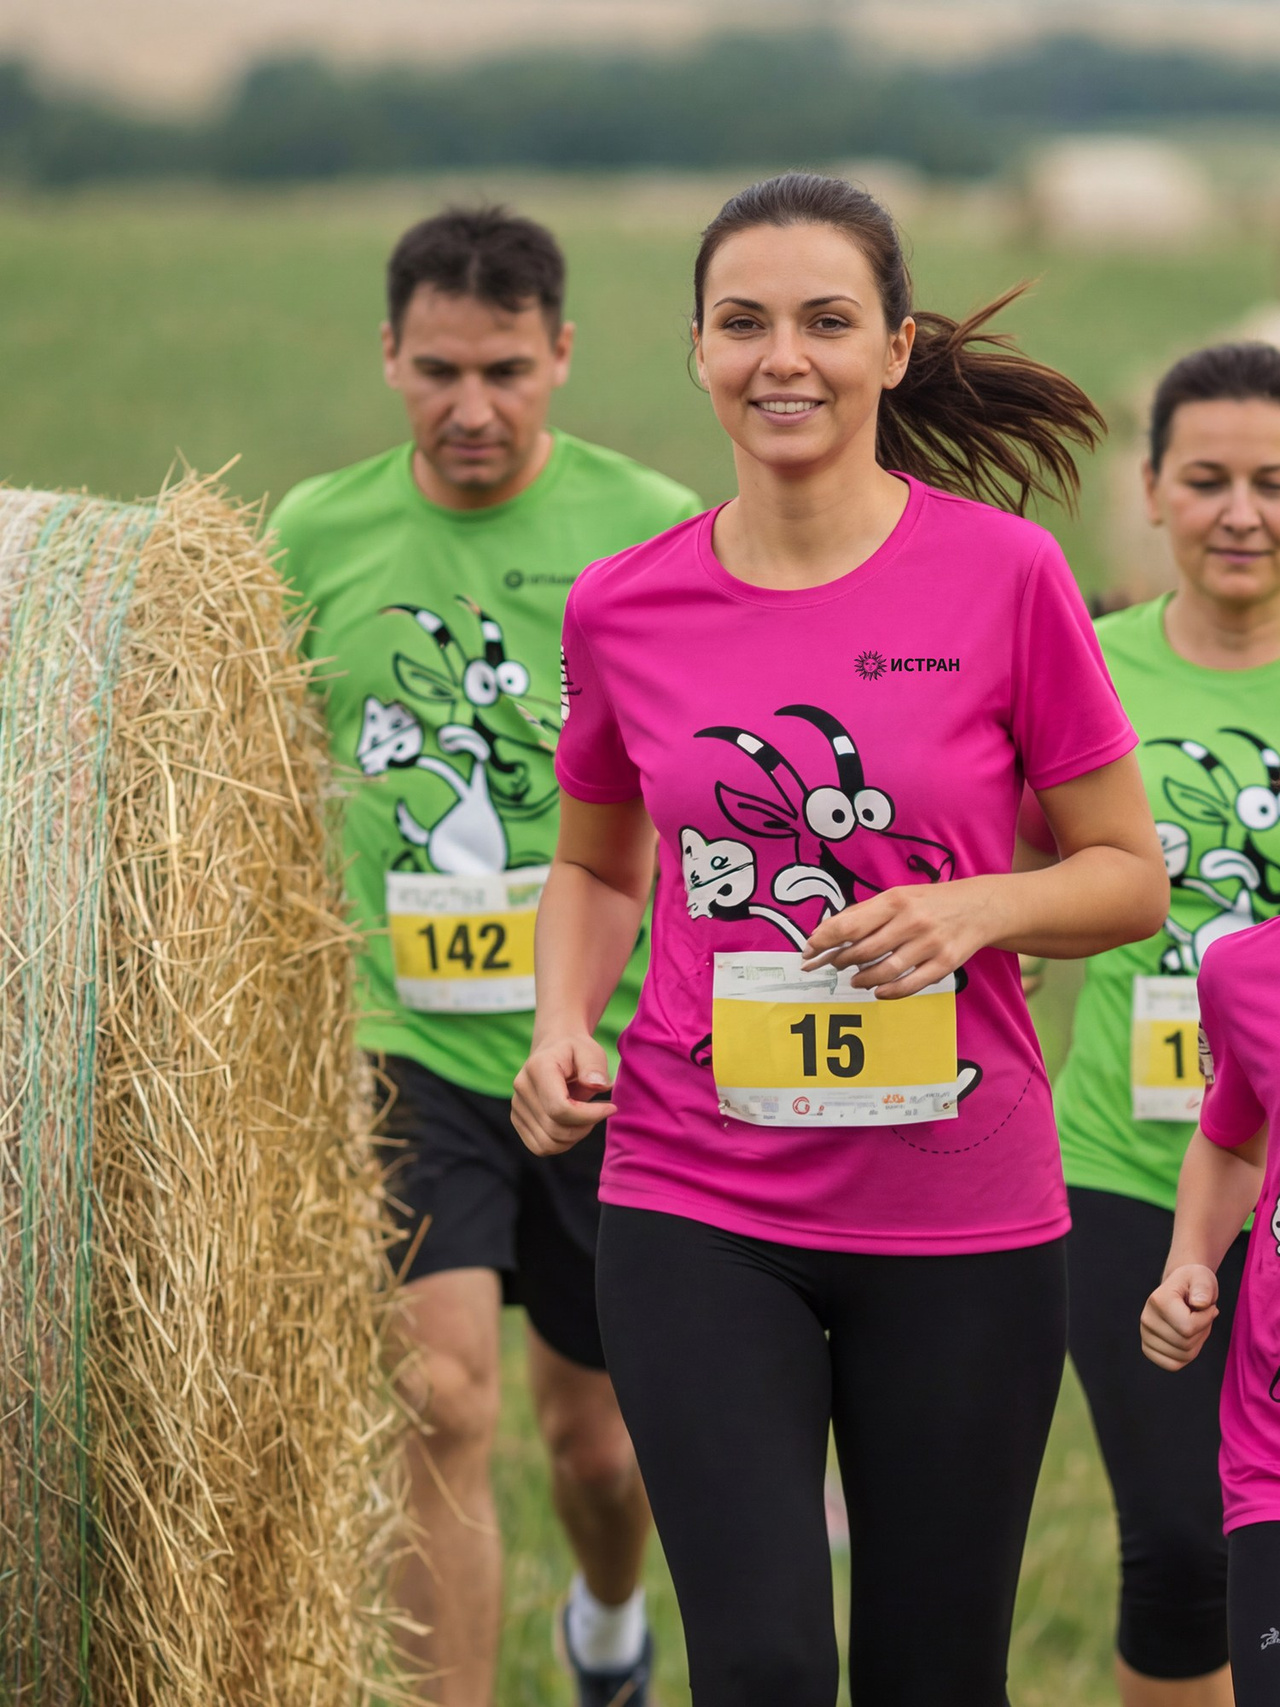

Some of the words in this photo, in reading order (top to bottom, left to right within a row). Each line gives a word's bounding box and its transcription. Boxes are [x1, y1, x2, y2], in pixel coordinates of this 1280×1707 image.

[890, 657, 960, 672] ИСТРАН
[418, 922, 511, 971] 142
[790, 1013, 865, 1078] 15
[1163, 1028, 1185, 1078] 1
